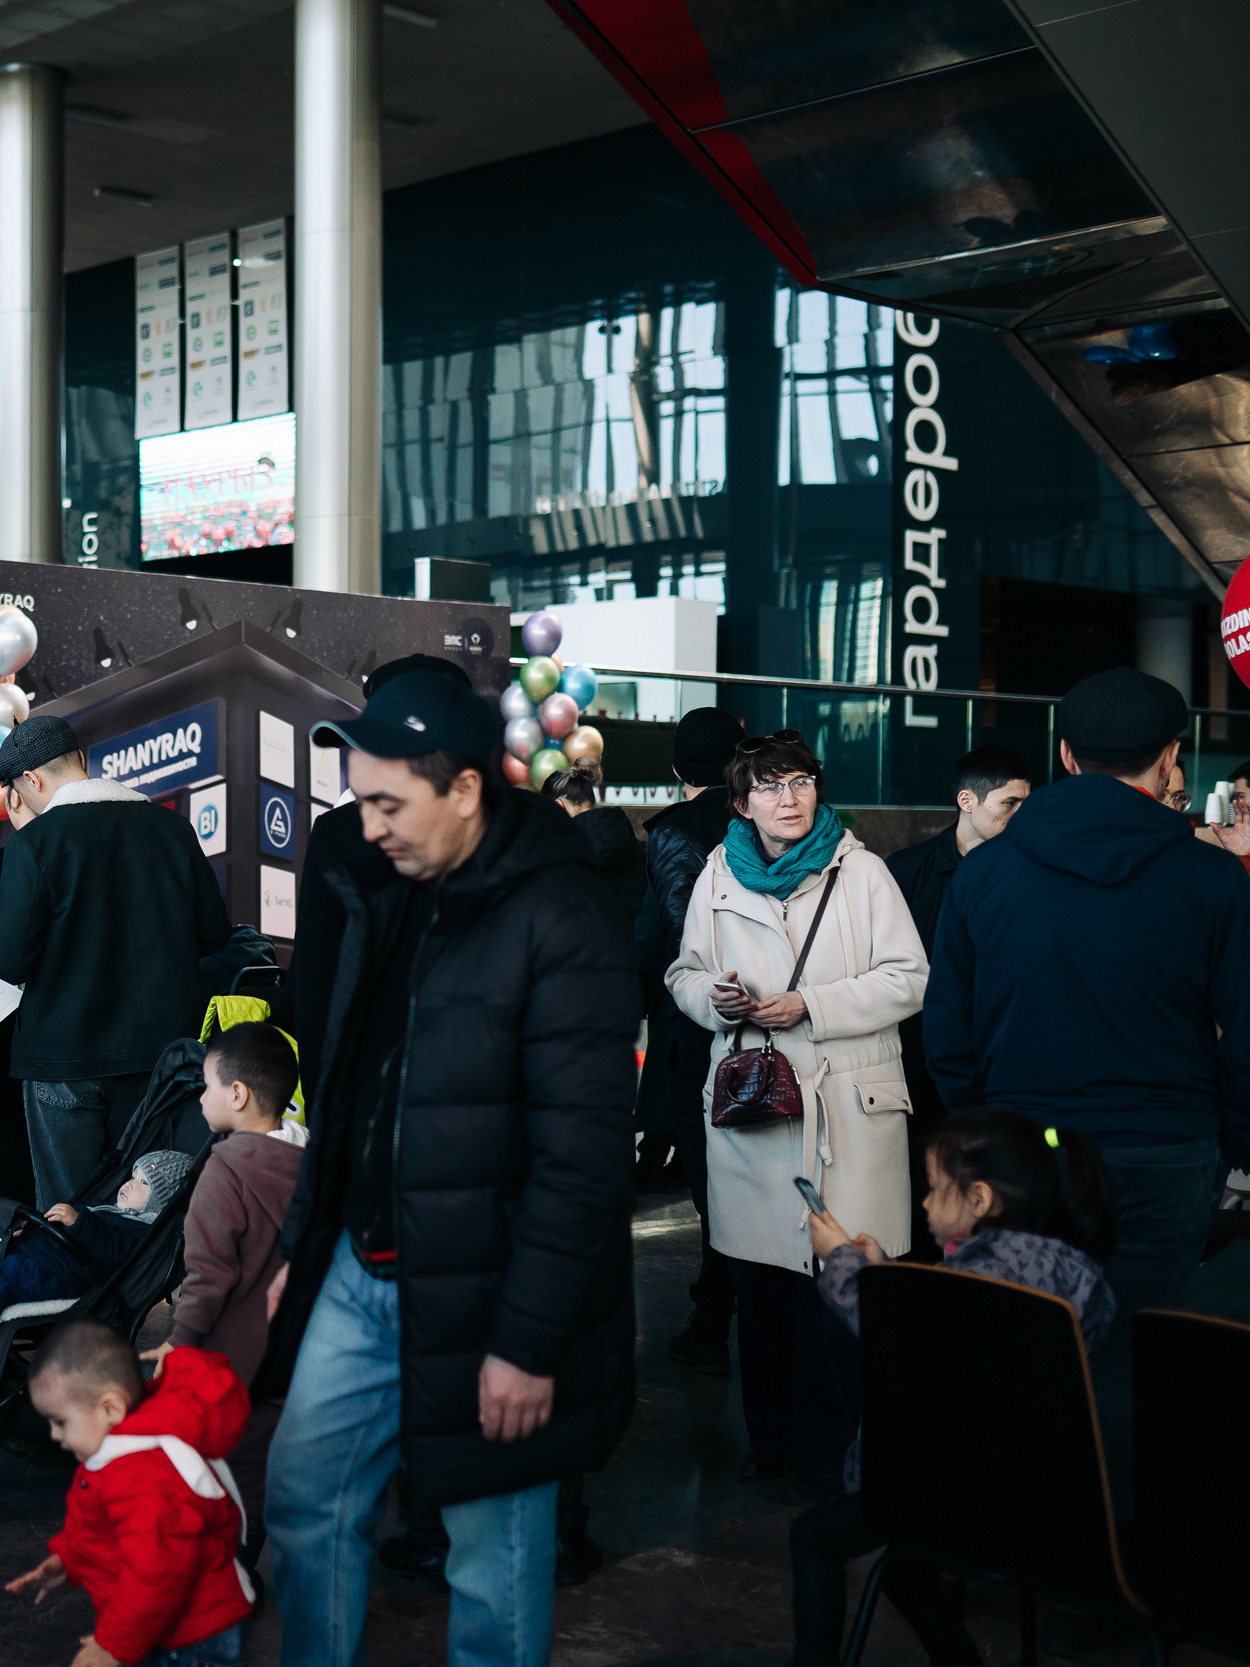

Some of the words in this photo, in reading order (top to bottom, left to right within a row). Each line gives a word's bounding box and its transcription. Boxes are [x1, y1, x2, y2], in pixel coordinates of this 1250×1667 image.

[896, 309, 959, 728] гардероб
[101, 722, 202, 780] SHANYRAQ
[200, 811, 216, 836] BI
